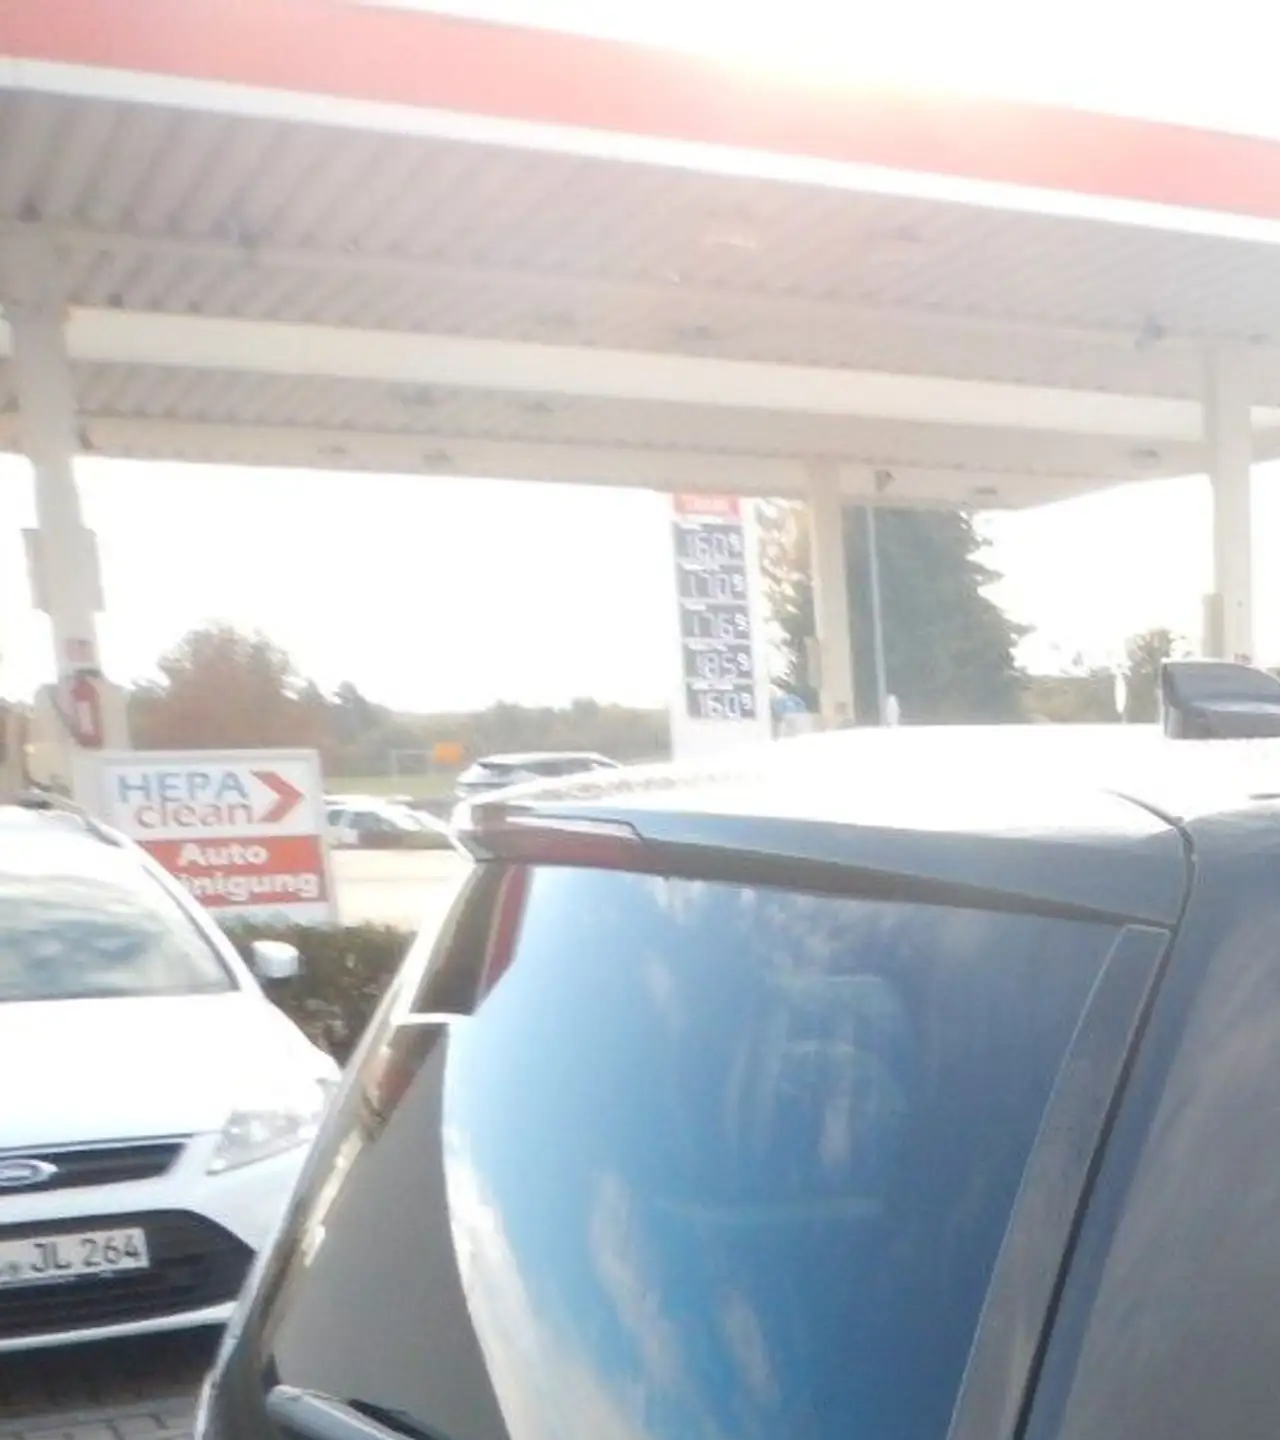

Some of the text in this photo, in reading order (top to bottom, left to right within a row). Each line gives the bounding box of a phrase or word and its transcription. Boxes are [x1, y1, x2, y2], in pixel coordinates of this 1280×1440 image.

[117, 769, 250, 804] HEPA
[134, 796, 254, 829] clean
[177, 842, 269, 866] Auto
[30, 1233, 140, 1273] JL 264
